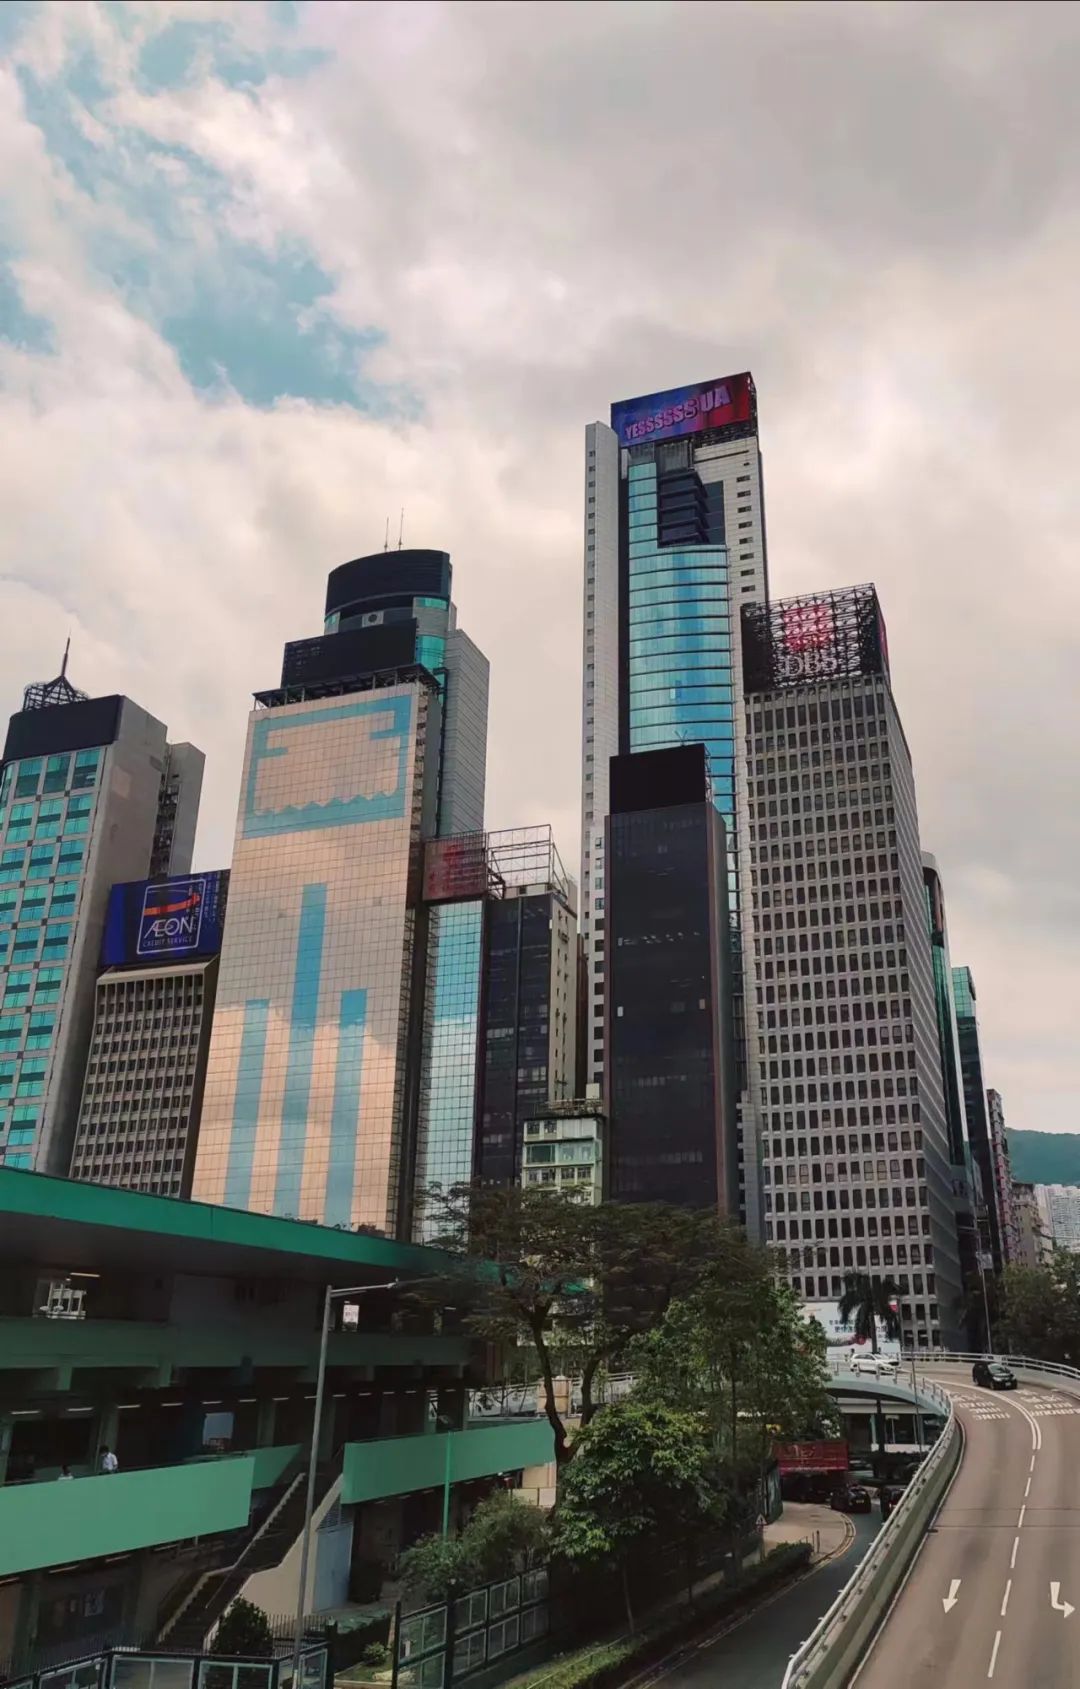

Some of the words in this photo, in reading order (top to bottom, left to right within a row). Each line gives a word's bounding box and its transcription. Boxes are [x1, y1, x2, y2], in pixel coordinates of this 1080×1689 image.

[698, 386, 731, 412] UA
[783, 648, 837, 677] DBS
[167, 936, 192, 944] SERVICE
